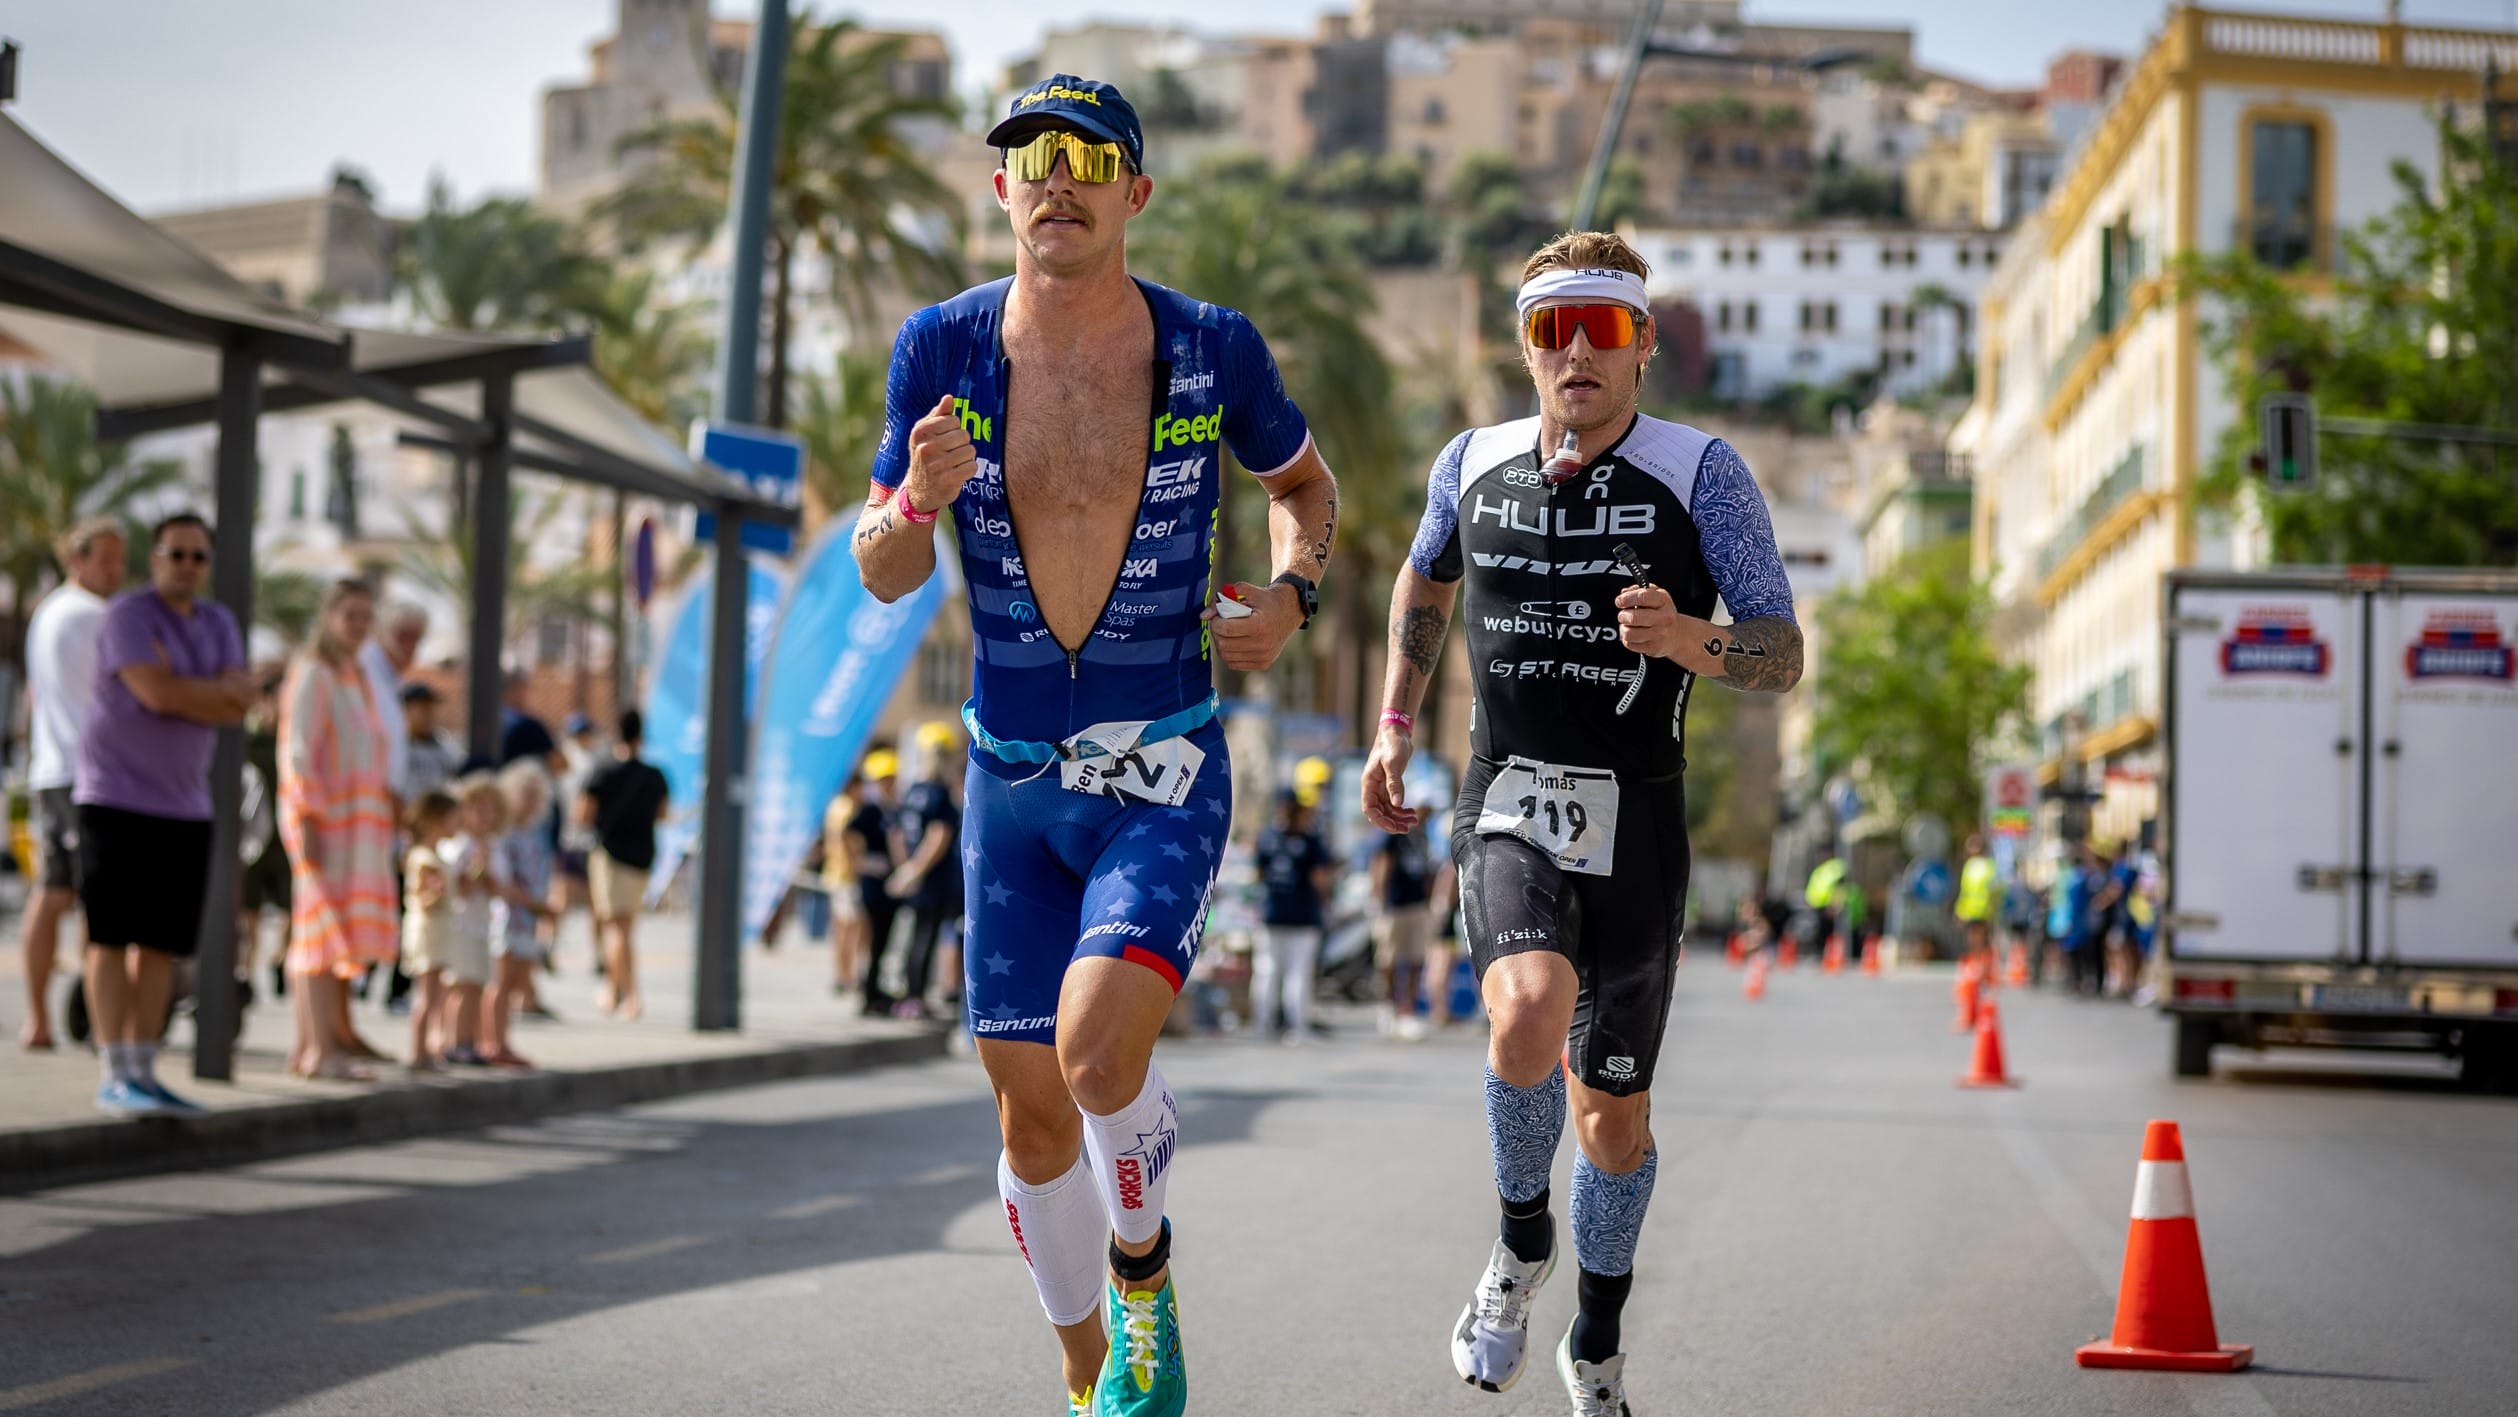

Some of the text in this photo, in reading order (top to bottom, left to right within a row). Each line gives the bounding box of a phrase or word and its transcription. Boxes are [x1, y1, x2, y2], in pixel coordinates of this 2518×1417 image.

[1503, 467, 1542, 488] PTO
[1471, 494, 1656, 538] HUUB
[1109, 600, 1159, 615] Master
[1103, 611, 1136, 628] Spas
[1597, 1069, 1639, 1080] RUDY
